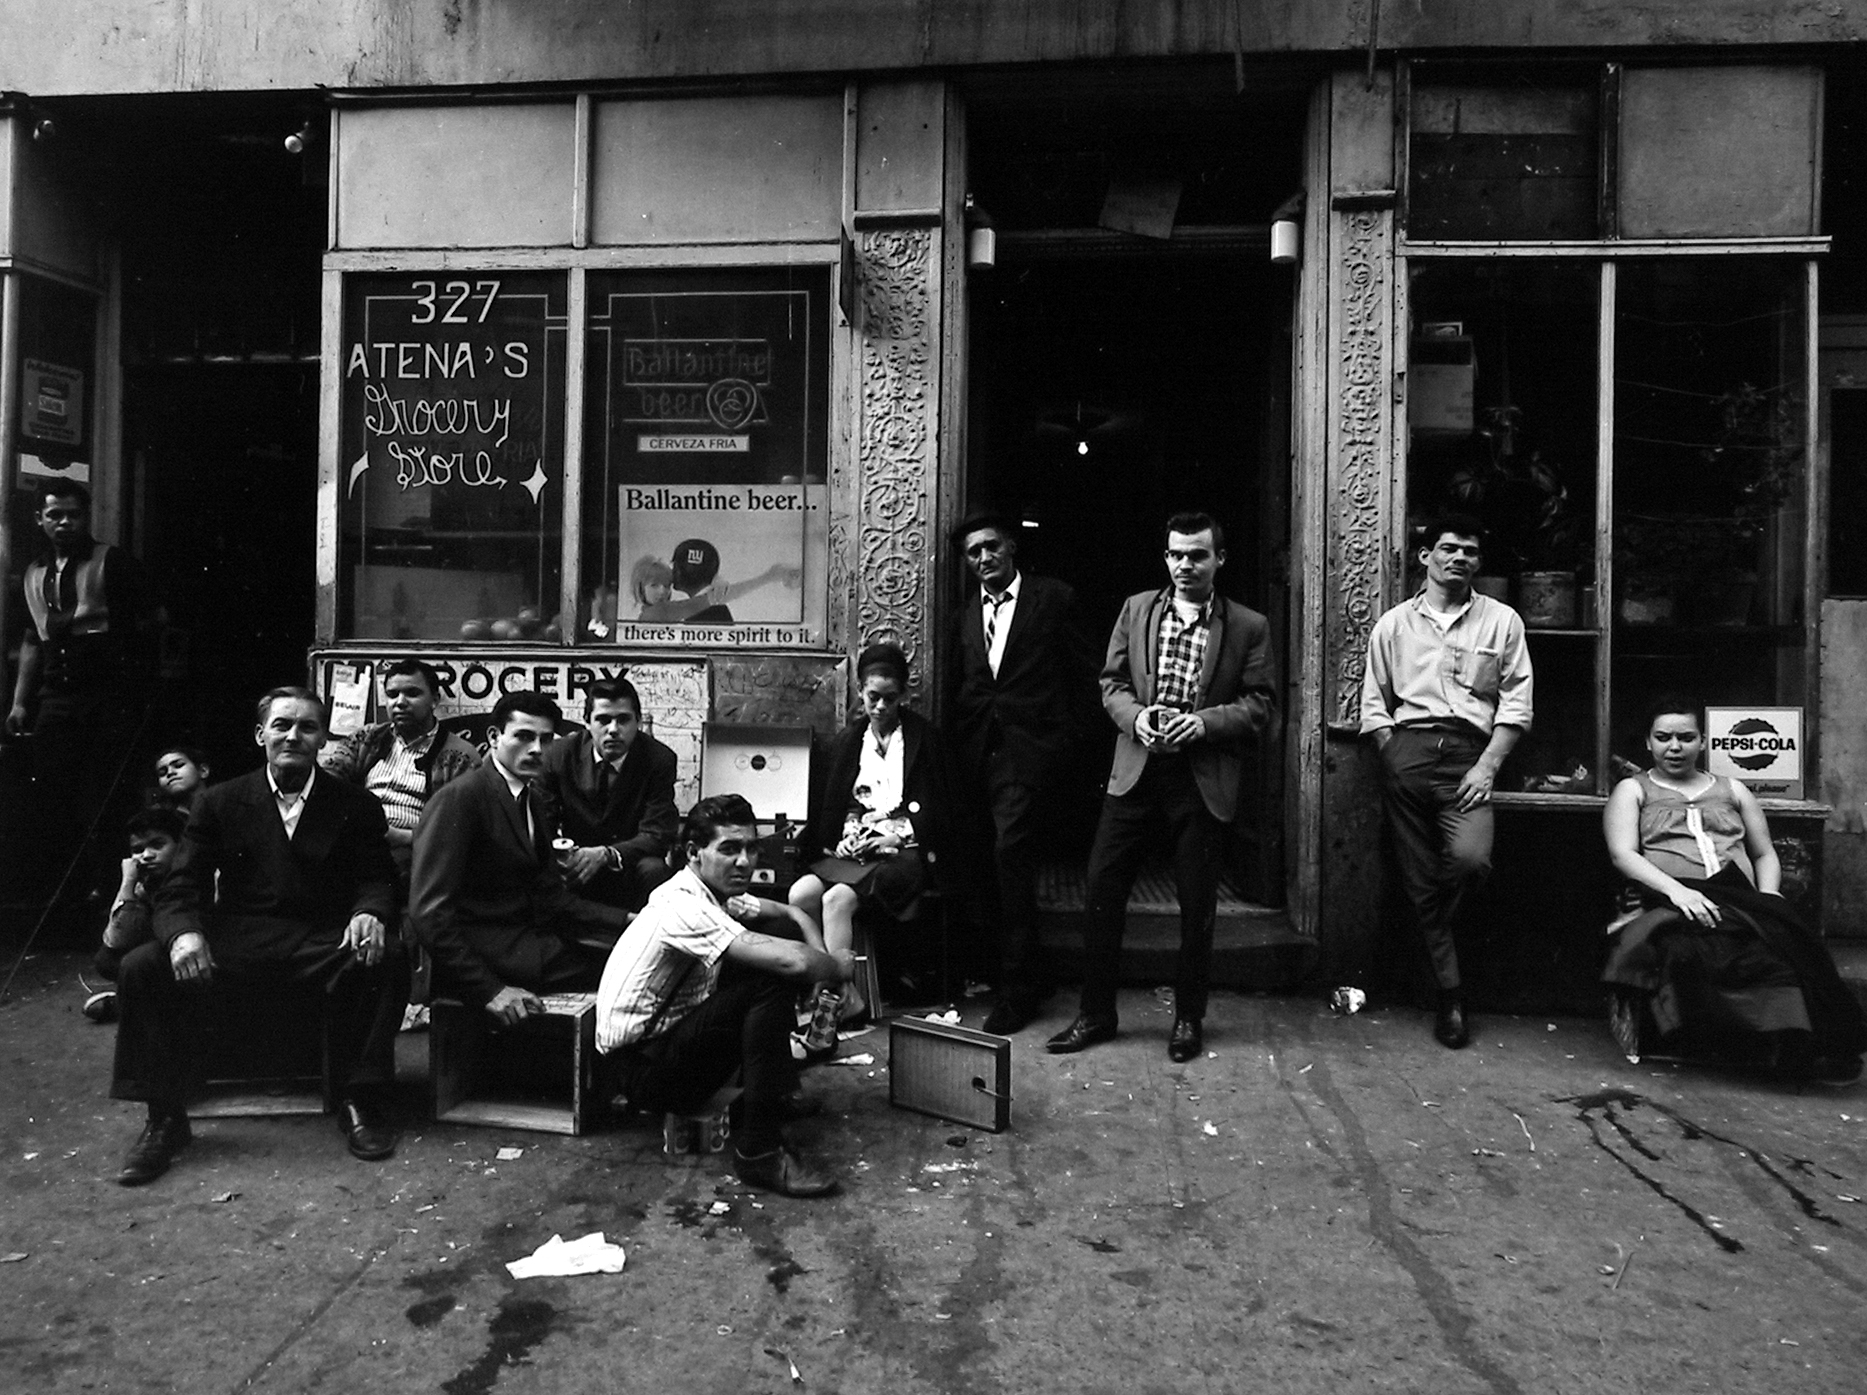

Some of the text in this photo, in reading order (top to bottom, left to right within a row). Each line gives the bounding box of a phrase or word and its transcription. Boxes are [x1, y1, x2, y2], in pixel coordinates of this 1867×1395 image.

[411, 280, 501, 324] 327
[347, 342, 529, 379] ATENA'S
[365, 383, 511, 448] Grocery
[649, 438, 738, 450] CERVEZA FRIA
[626, 488, 741, 511] Ballantine
[624, 625, 816, 645] there's more spirit to it.
